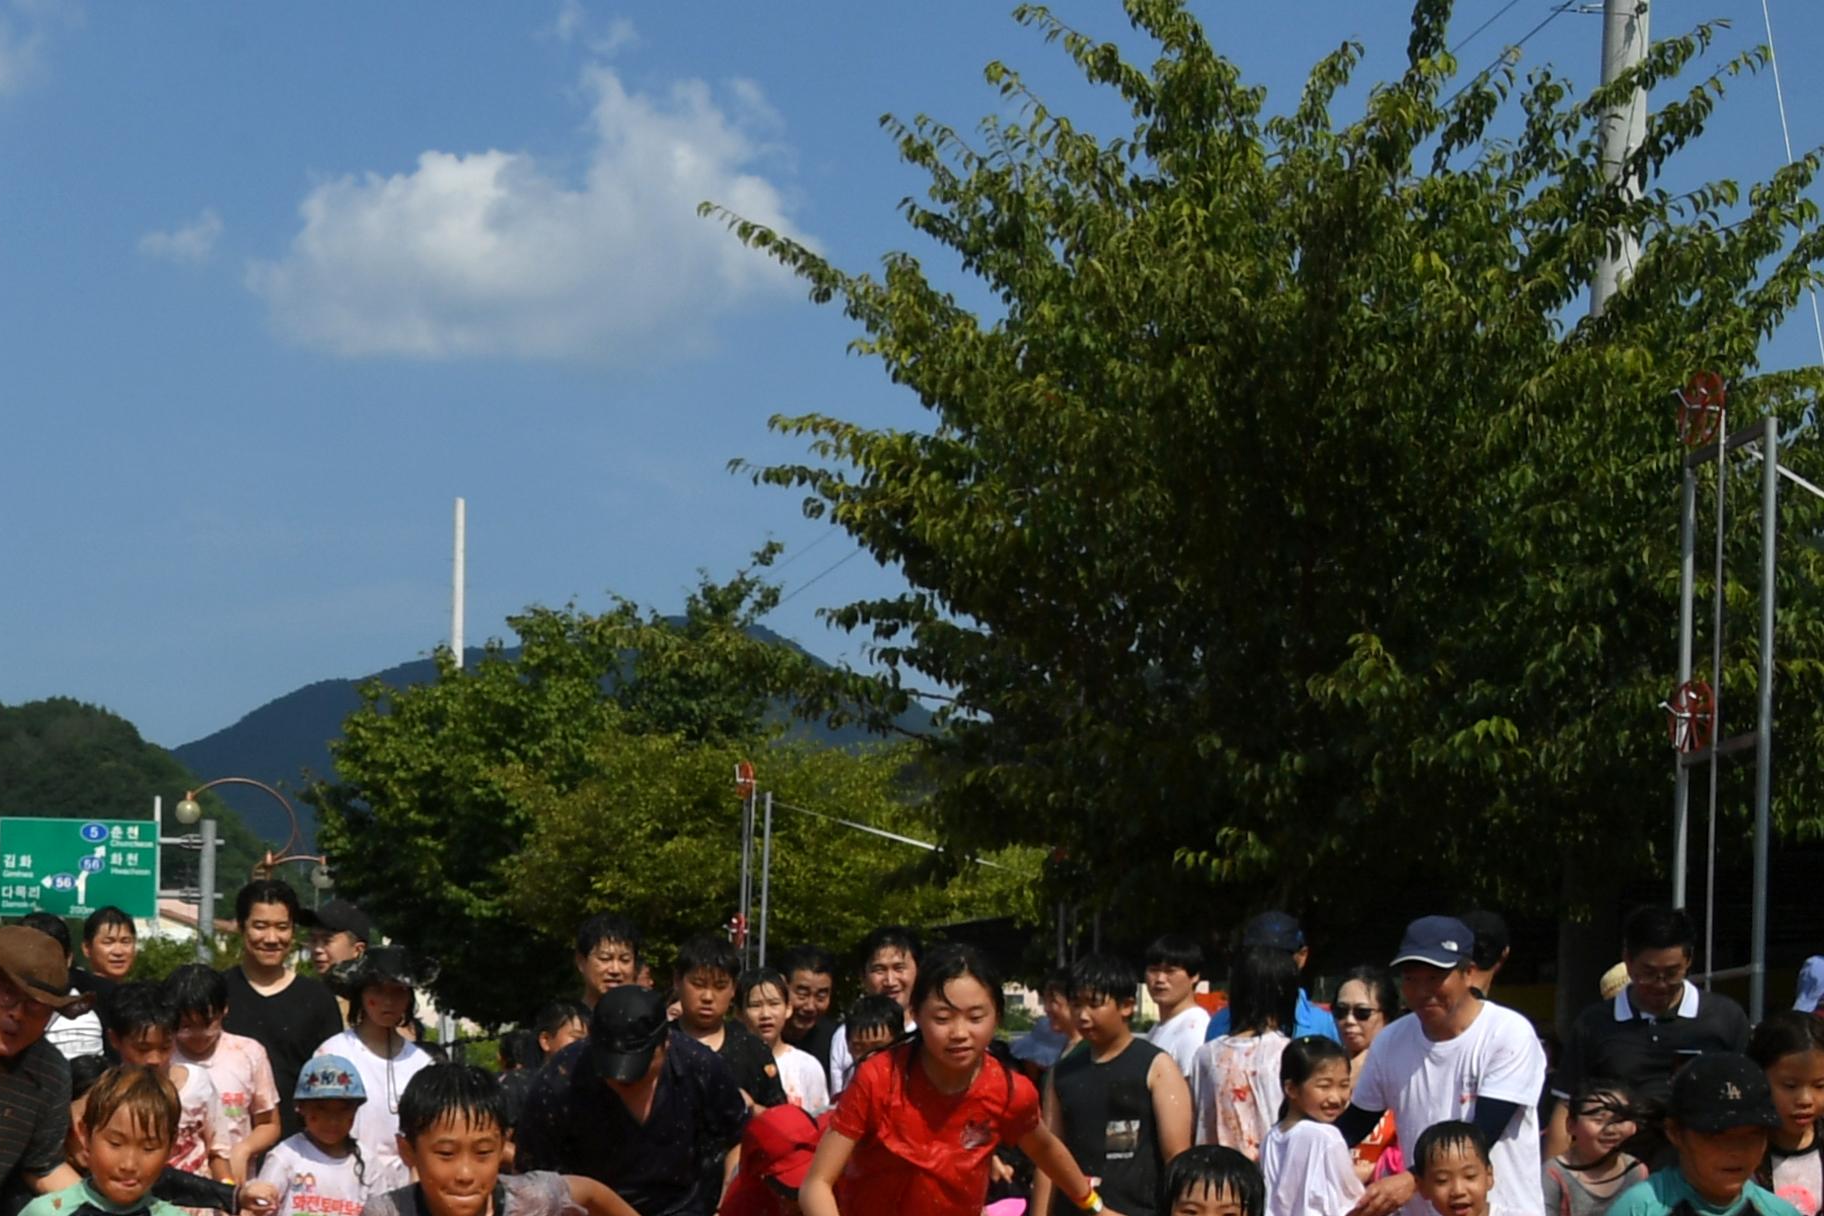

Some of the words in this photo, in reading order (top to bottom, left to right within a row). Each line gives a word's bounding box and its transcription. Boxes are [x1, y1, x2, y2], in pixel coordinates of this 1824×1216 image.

[90, 826, 98, 838] 5
[84, 859, 100, 870] 56
[55, 876, 72, 888] 56
